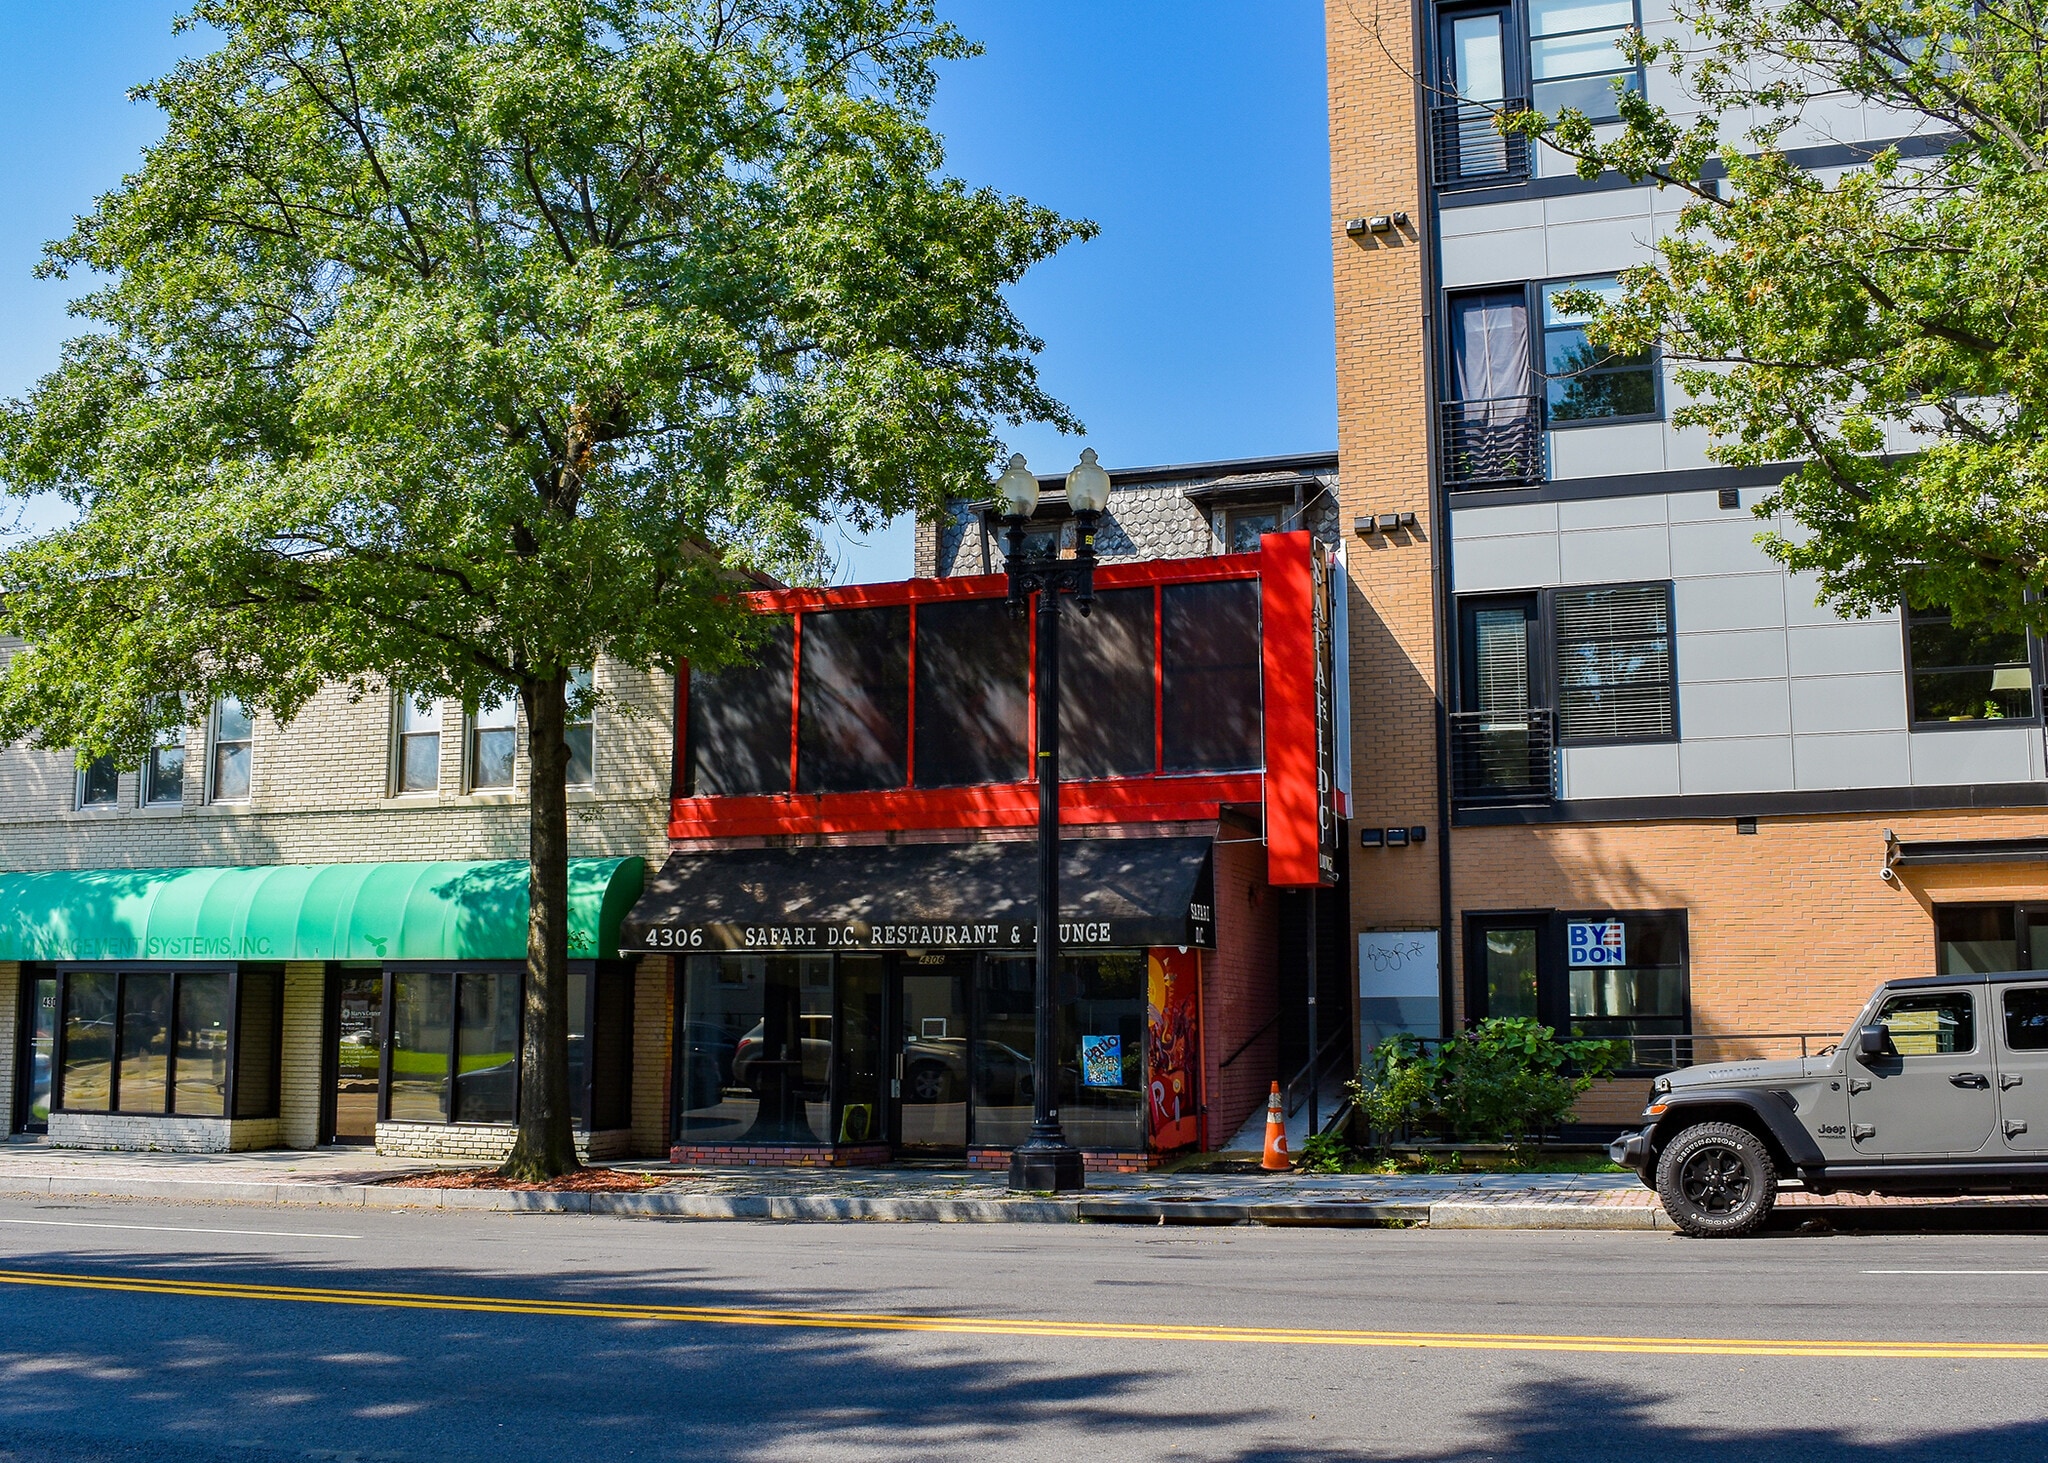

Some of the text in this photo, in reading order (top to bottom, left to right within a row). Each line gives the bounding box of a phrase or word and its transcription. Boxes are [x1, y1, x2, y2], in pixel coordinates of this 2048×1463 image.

[1190, 902, 1210, 922] SAFARI
[645, 923, 1111, 947] 4306 SAFARI D.C. RESTAURANT & UNGE
[1571, 925, 1621, 946] BYE
[240, 936, 275, 955] INC.
[1572, 947, 1622, 963] DON
[919, 955, 945, 965] 4306
[1817, 1123, 1846, 1135] Jeep
